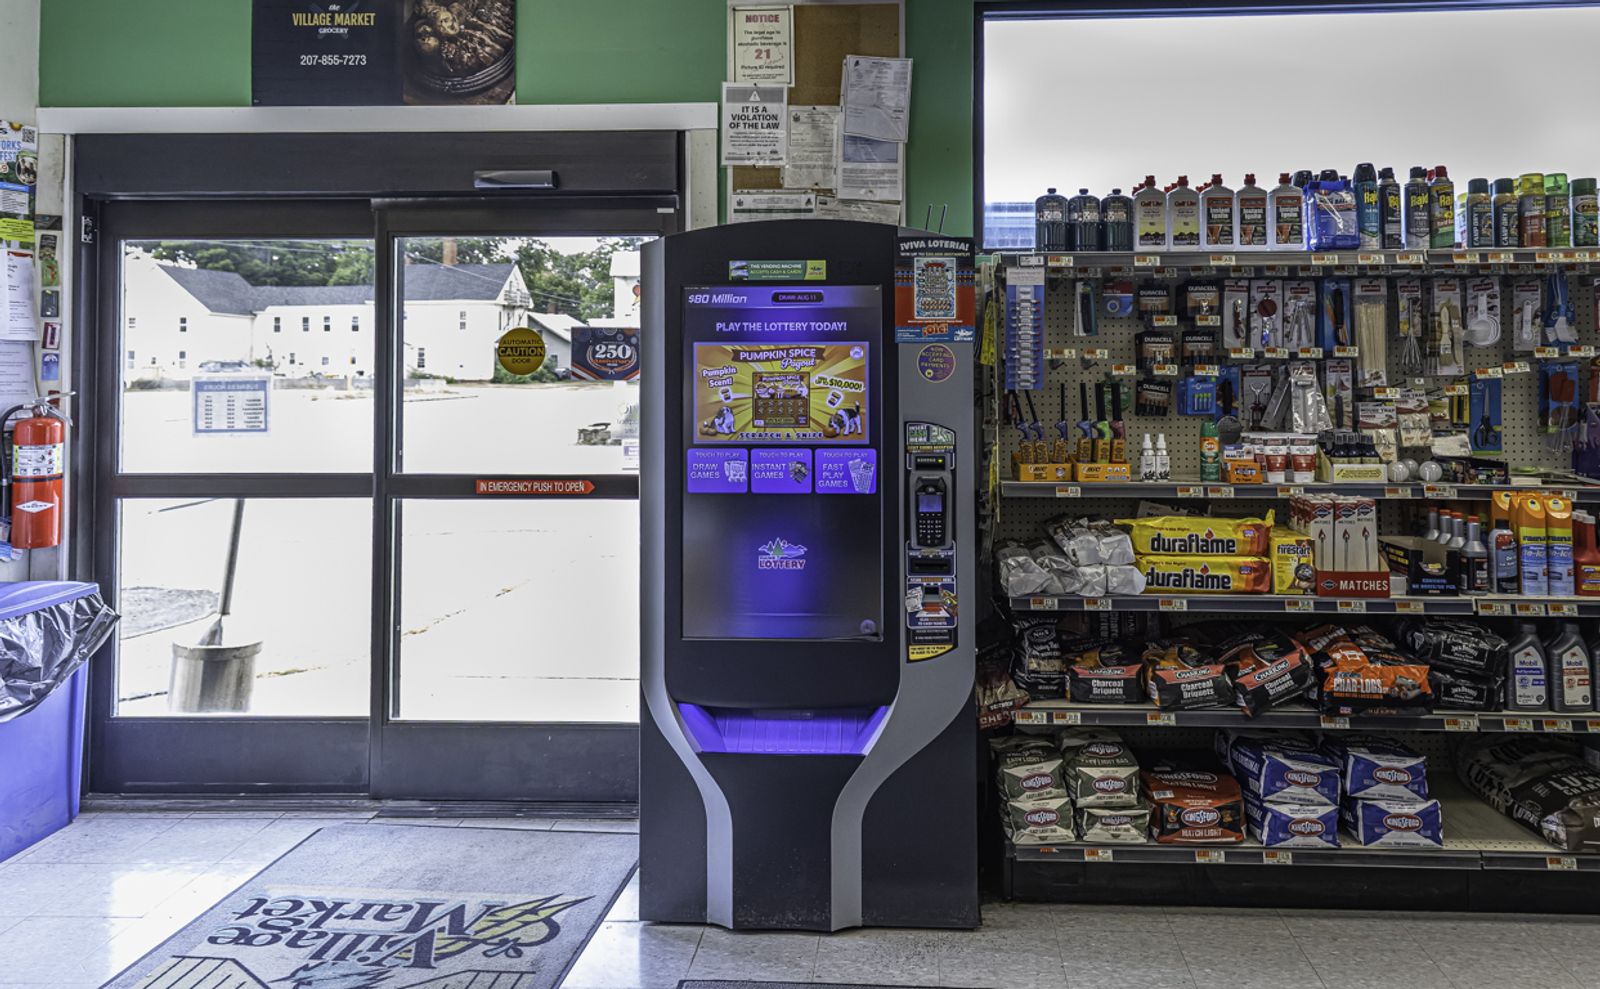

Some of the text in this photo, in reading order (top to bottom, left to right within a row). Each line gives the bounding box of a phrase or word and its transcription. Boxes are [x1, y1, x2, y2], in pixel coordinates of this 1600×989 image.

[292, 13, 376, 26] VILLAGE MARKET
[745, 14, 780, 23] NOTICE
[300, 54, 367, 66] 207-855-7273
[755, 49, 771, 60] 21
[1410, 193, 1429, 207] Raid
[711, 293, 748, 304] Million
[716, 322, 848, 332] PLAY THE LOTTERY TODAY!
[499, 347, 545, 356] CAUTION
[595, 344, 632, 359] 250
[739, 348, 817, 361] PUMPKIN SPICE
[780, 358, 816, 371] Payout
[701, 366, 737, 377] Pumpkin
[708, 378, 734, 388] Scent!
[828, 377, 863, 390] $10,000!
[1142, 383, 1170, 393] DURACELL
[692, 463, 718, 471] DRAW
[752, 463, 786, 471] INSTANT
[822, 463, 844, 471] FAST
[690, 471, 720, 479] GAMES
[754, 471, 784, 479] GAMES
[822, 471, 844, 479] PLAY
[480, 481, 585, 492] IN EMERGENCY PUSH TO OPEN
[818, 480, 848, 488] GAMES
[1150, 532, 1237, 554] duraflame
[759, 559, 806, 569] LOTTERY
[1146, 566, 1232, 590] duraflame
[1339, 580, 1389, 591] MATCHES
[1091, 679, 1124, 687] Charcoal
[1181, 679, 1214, 692] Charcoal
[1264, 672, 1292, 691] Charcoal
[1333, 677, 1383, 694] CHAR-LOGS
[1092, 687, 1123, 695] Briquets
[1182, 687, 1215, 699] Briquets
[1286, 773, 1317, 784] KINGSFORD
[1376, 770, 1409, 782] KINGSFORD
[1022, 775, 1053, 789] KINGSFORD
[1095, 779, 1126, 791] KINGSFORD
[1027, 811, 1058, 824] KINGSFORD
[1184, 809, 1218, 824] KINGSFORD
[1290, 822, 1321, 833] KINGSFORD
[1386, 817, 1420, 828] KINGSFORD
[1181, 829, 1222, 837] MATCH LIGHT
[236, 898, 501, 936] Market
[208, 917, 437, 969] Village
